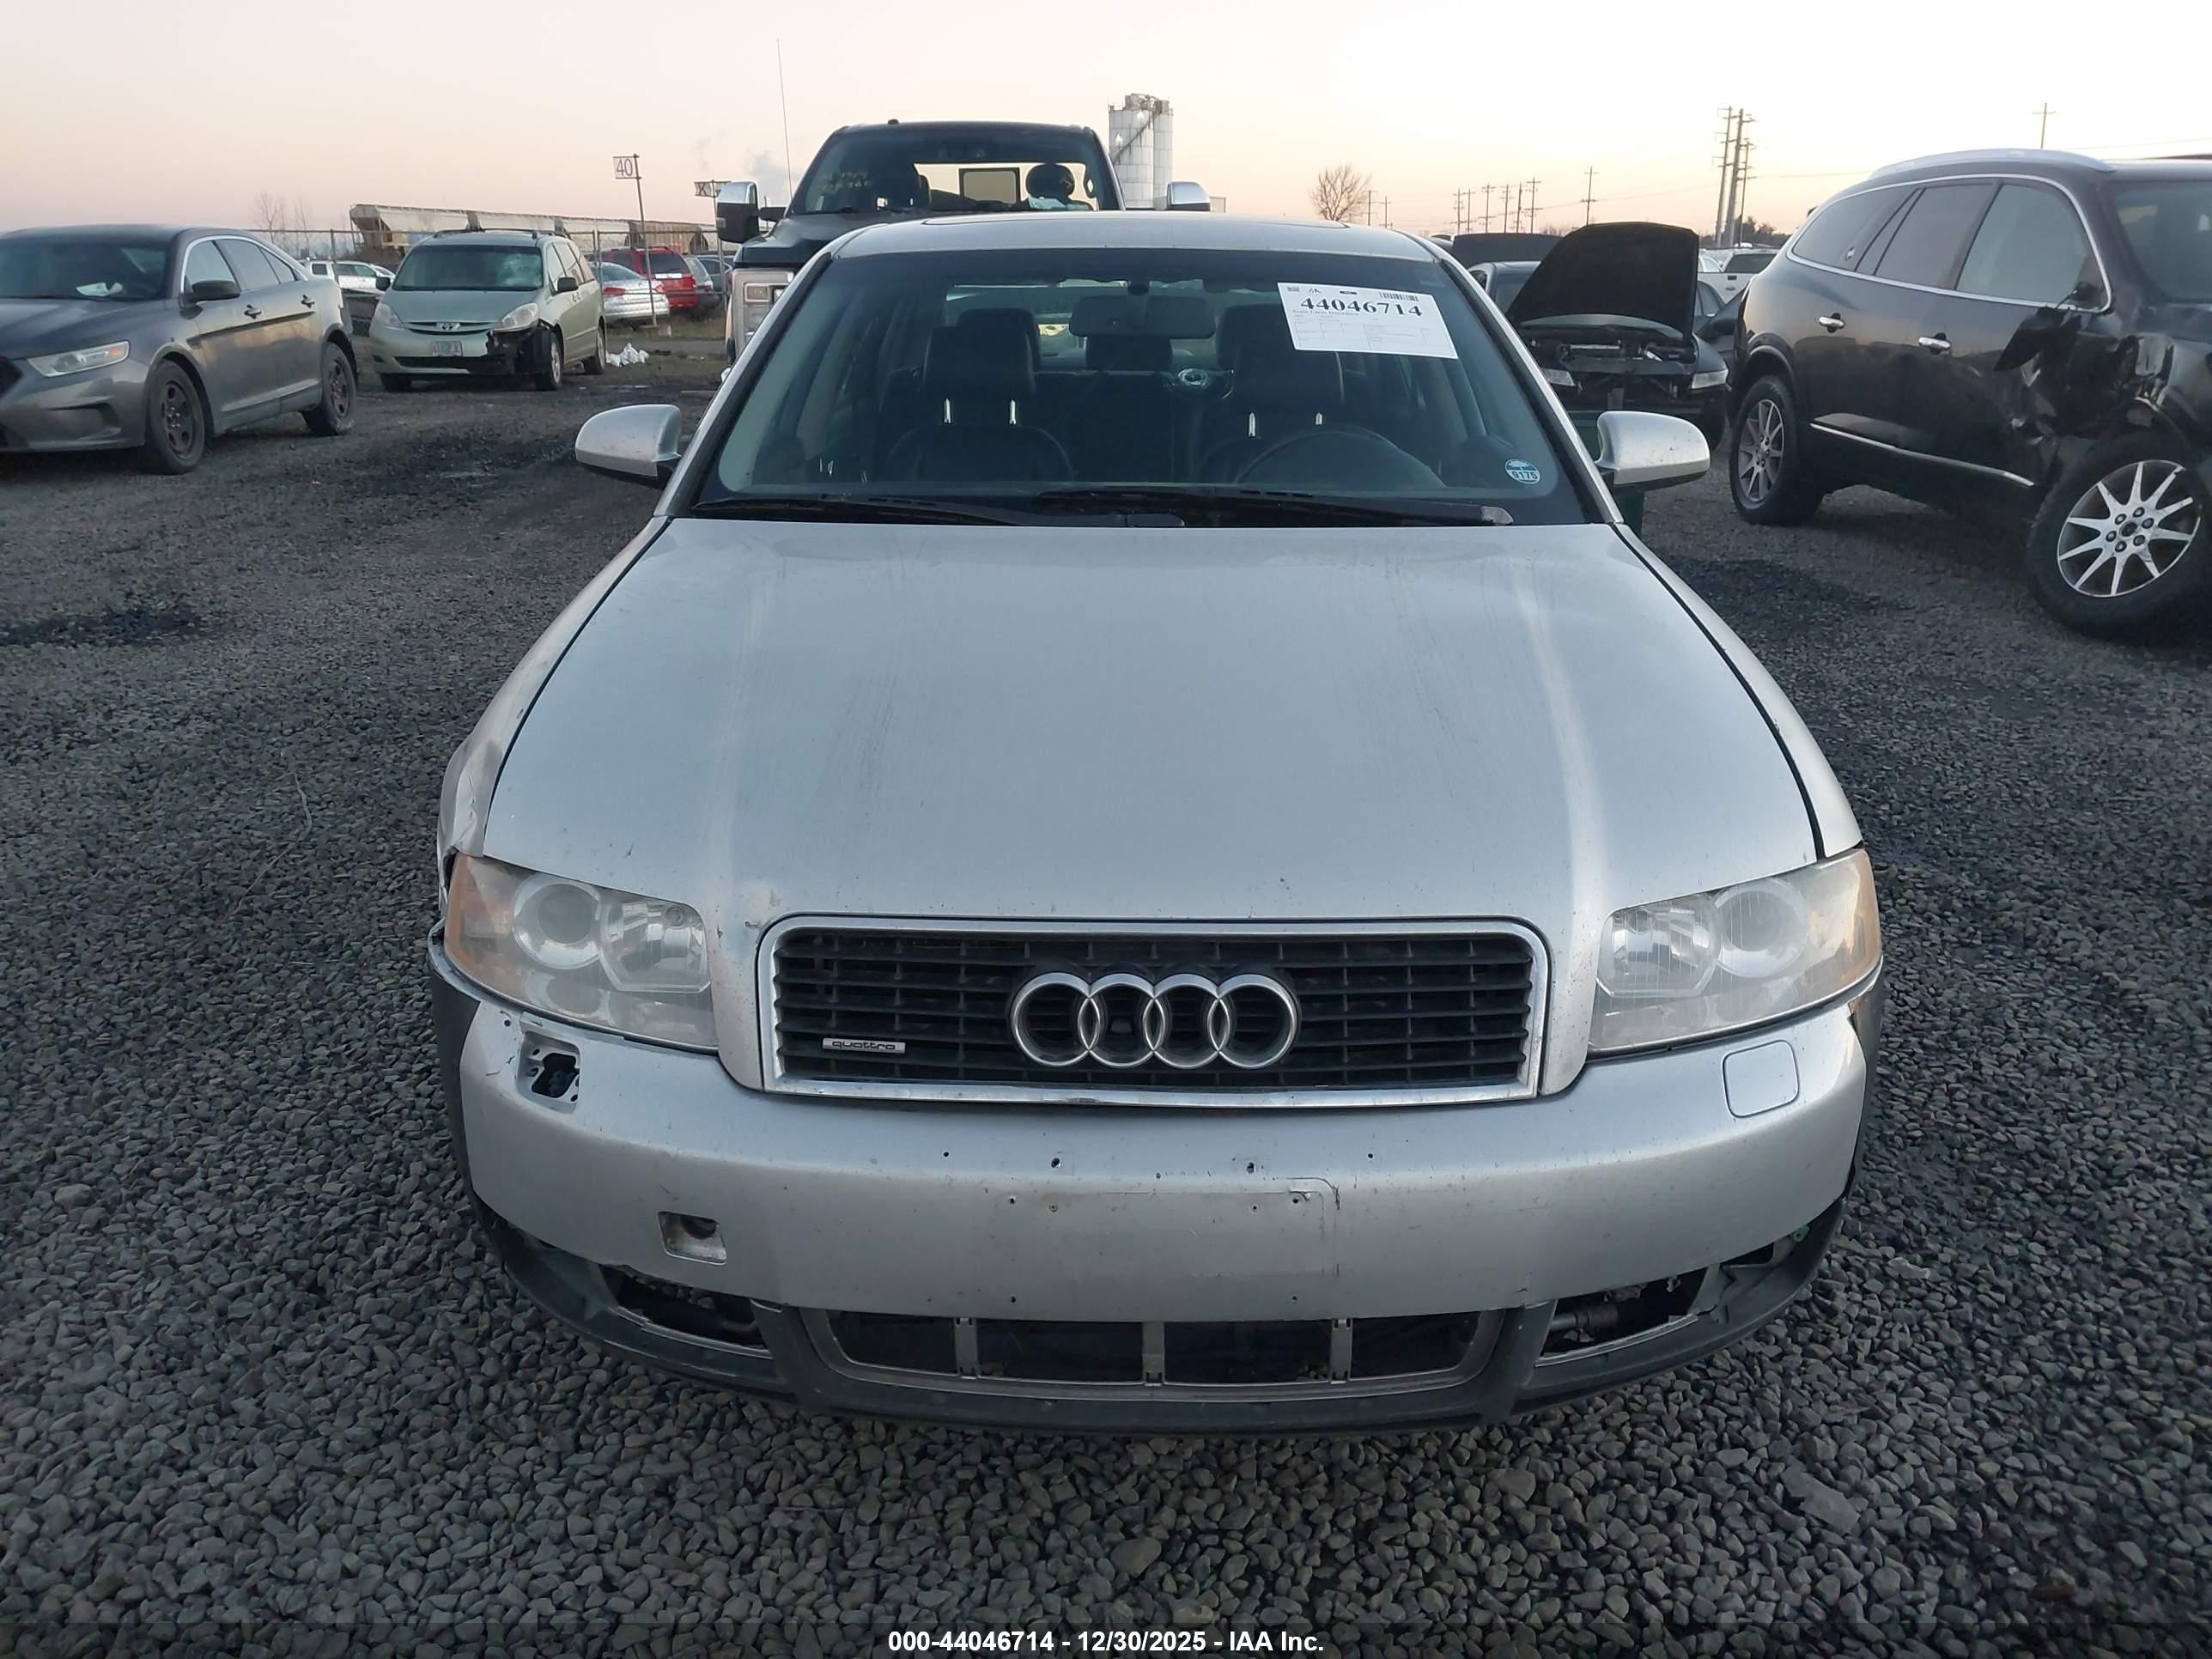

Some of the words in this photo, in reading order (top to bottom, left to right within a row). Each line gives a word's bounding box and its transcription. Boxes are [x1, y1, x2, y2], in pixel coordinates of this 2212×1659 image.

[617, 158, 634, 176] 40
[1301, 297, 1422, 316] 44046714
[832, 1041, 896, 1050] quattro
